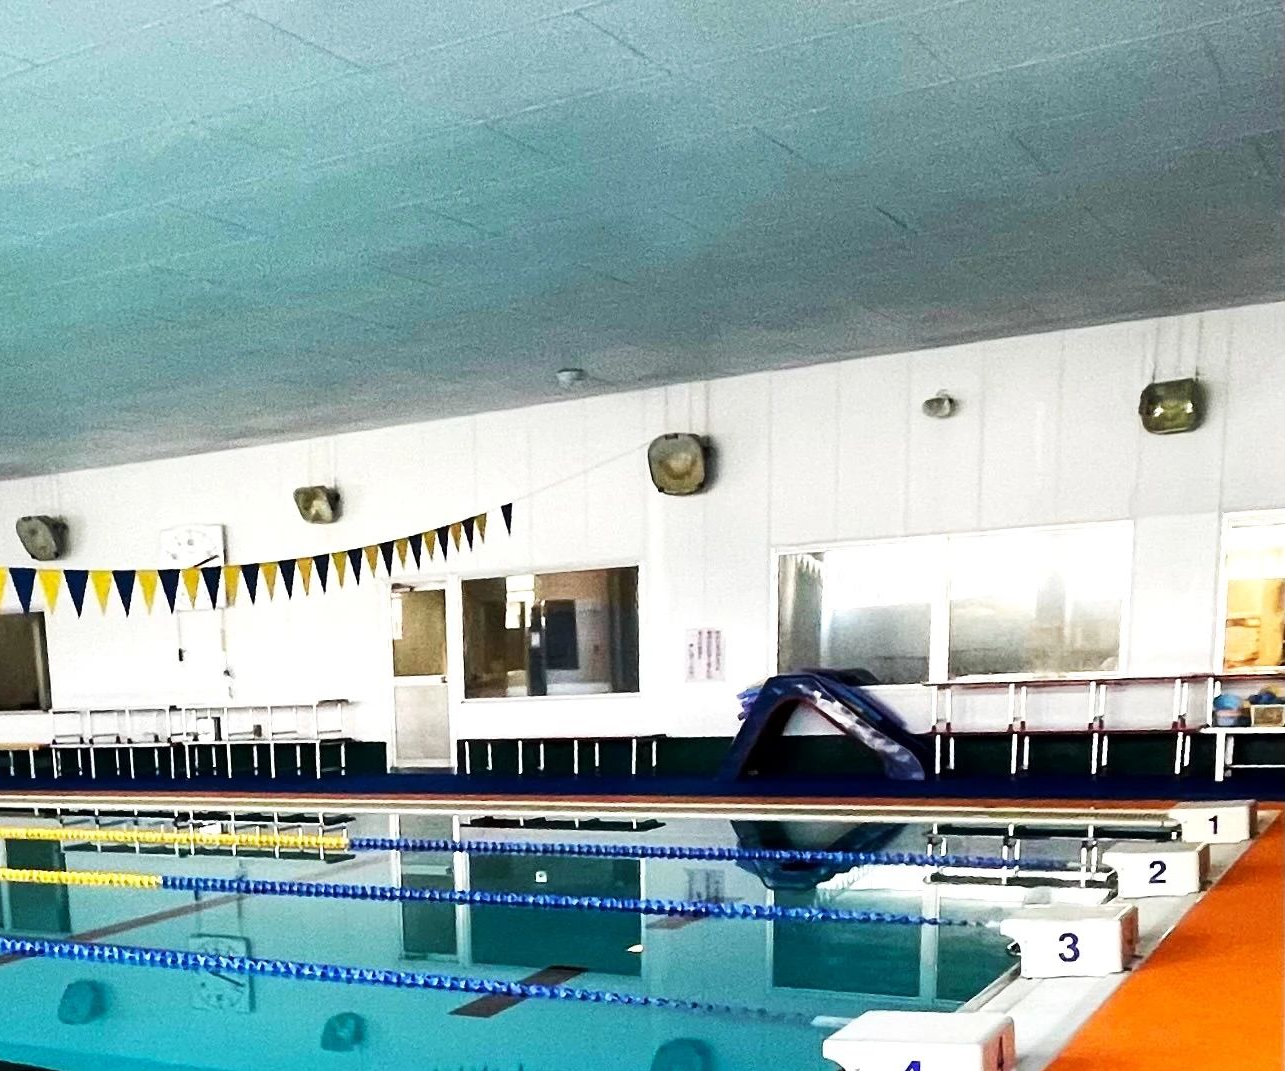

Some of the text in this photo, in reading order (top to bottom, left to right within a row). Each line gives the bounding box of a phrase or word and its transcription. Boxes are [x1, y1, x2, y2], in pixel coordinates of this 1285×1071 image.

[1207, 814, 1219, 835] 1
[1148, 860, 1167, 884] 2
[1058, 932, 1080, 963] 3
